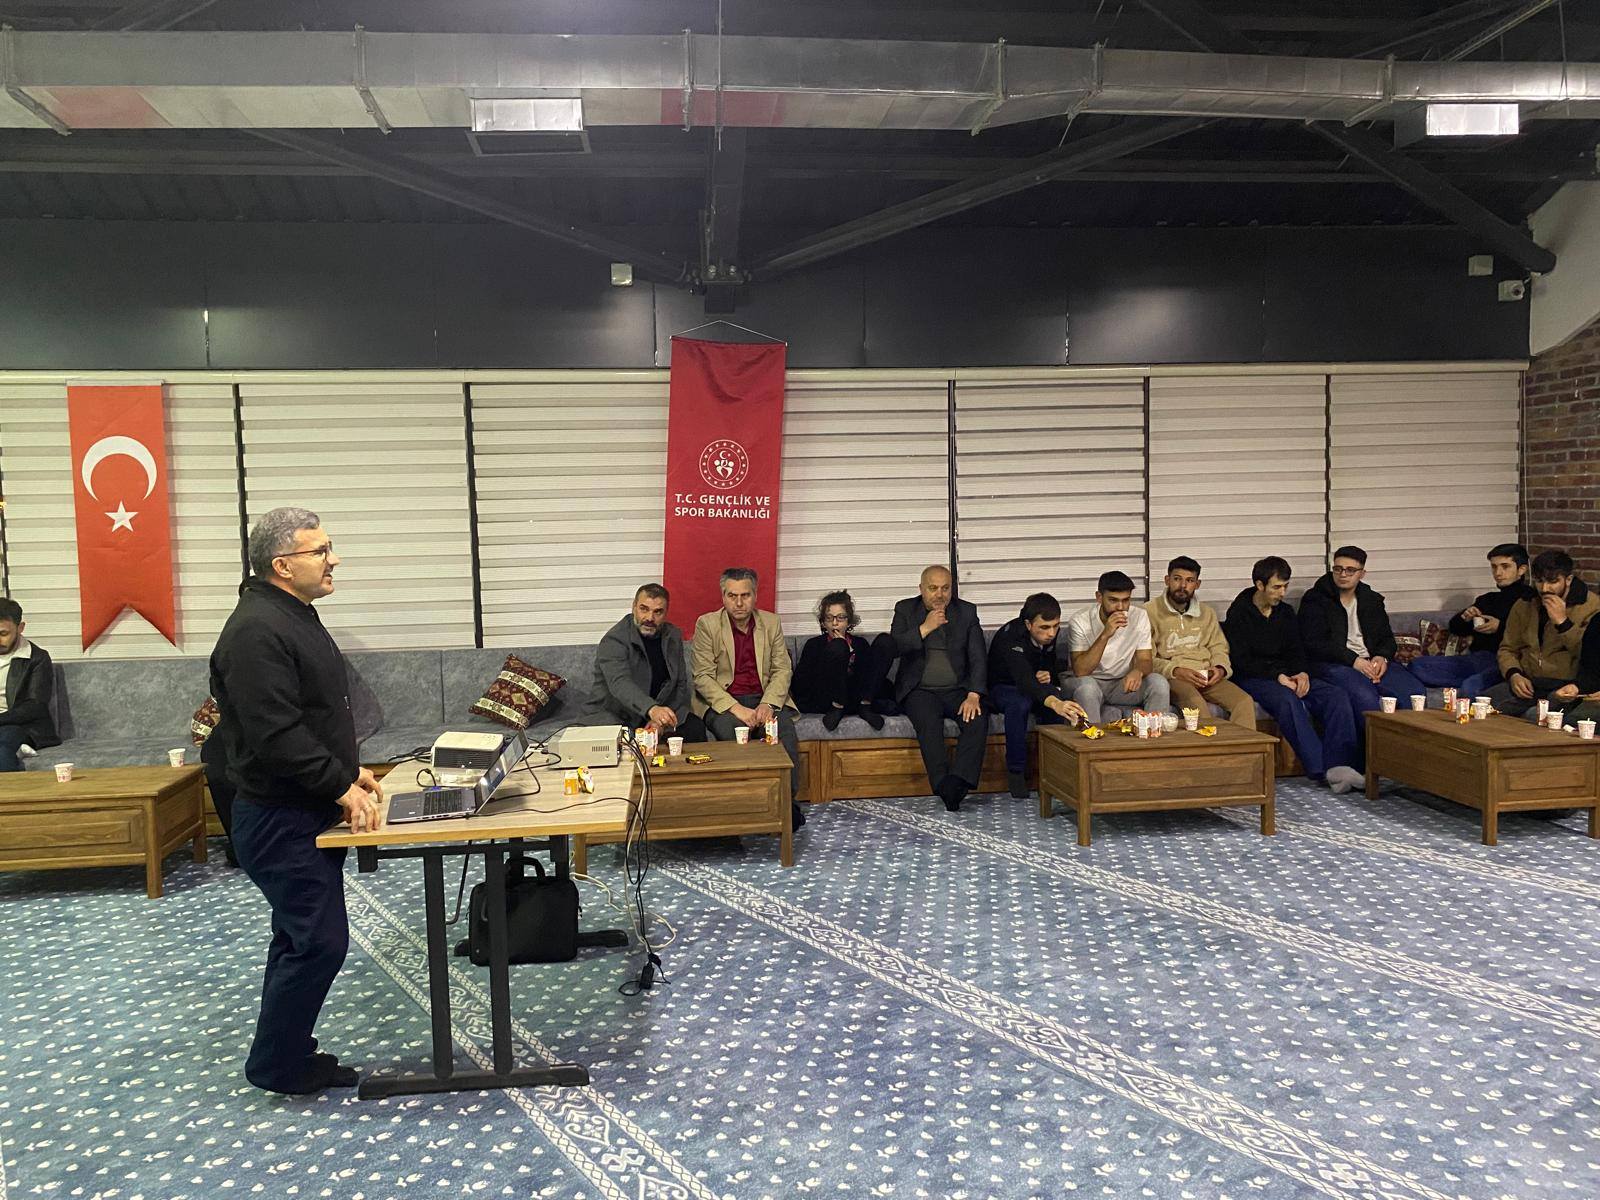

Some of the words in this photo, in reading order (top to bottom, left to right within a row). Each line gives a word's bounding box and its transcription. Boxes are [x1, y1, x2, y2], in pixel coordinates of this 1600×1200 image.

[674, 493, 696, 504] T.C.
[699, 494, 752, 507] GENÇLİK
[755, 496, 770, 506] VE
[674, 507, 705, 517] SPOR
[708, 508, 770, 519] BAKANLIĞI
